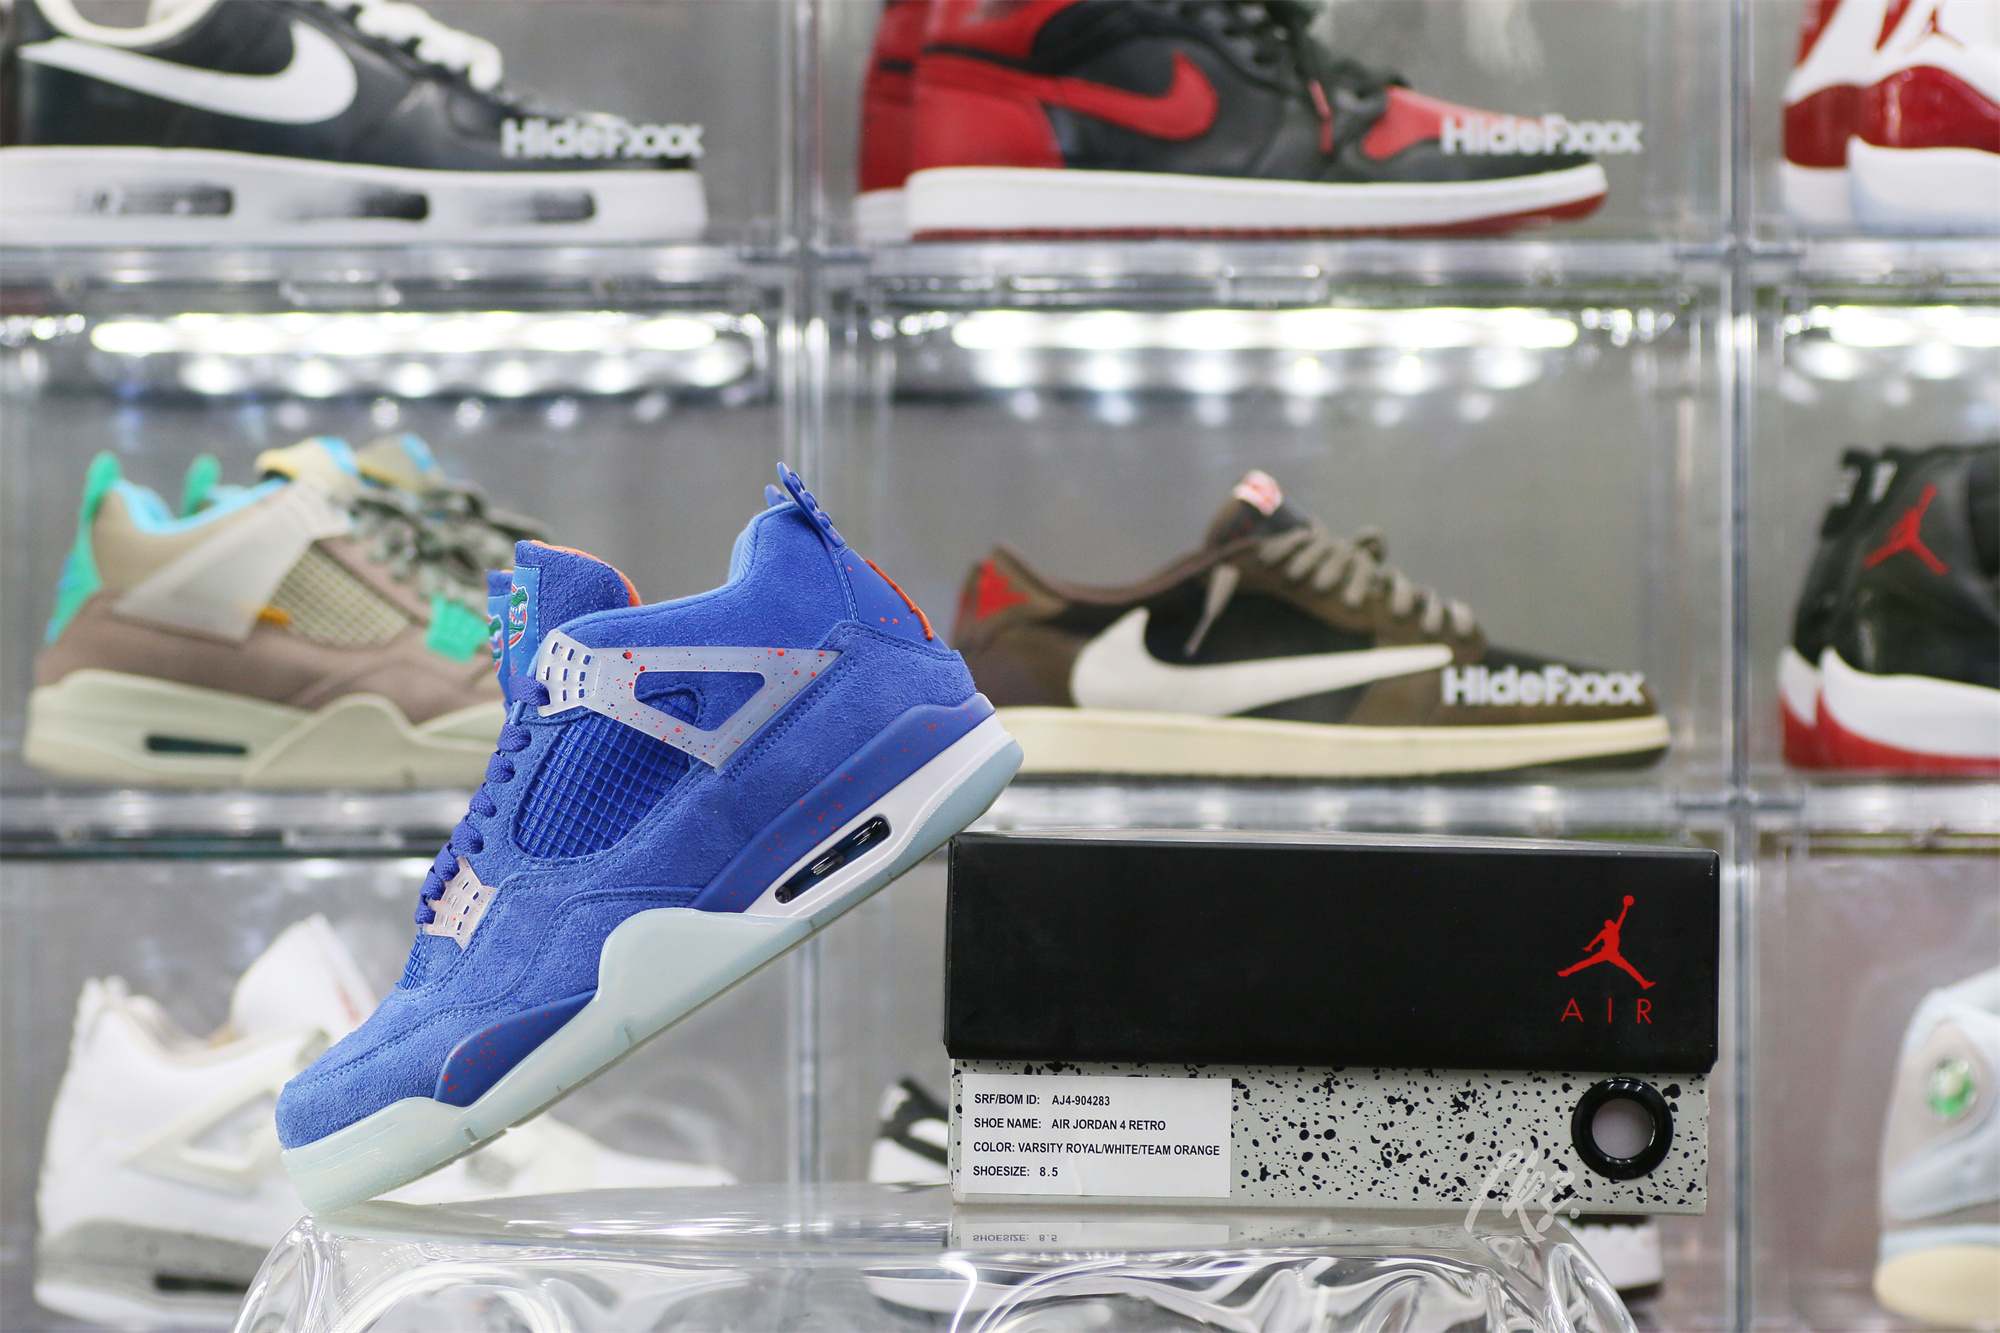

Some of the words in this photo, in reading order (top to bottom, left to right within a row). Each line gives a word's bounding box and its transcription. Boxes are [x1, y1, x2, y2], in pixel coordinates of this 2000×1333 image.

[1441, 664, 1645, 706] HideFxxx
[1560, 997, 1652, 1024] AIR
[974, 1093, 1024, 1106] SRF/BOM
[1026, 1094, 1041, 1106] ID:
[1051, 1094, 1111, 1107] AJ4-904283
[973, 1117, 1005, 1129] SHOE
[1006, 1117, 1042, 1130] NAME:
[1051, 1119, 1071, 1130] AIR
[1072, 1119, 1118, 1131] JORDAN
[1119, 1119, 1127, 1131] 4
[1128, 1119, 1167, 1131] RETRO
[973, 1141, 1016, 1153] COLOR:
[1017, 1142, 1064, 1154] VARSITY
[1065, 1142, 1171, 1156] ROYAL/WHITE/TEAM
[1173, 1144, 1221, 1156] ORANGE
[972, 1165, 1030, 1177] SHOESIZE:
[1039, 1166, 1059, 1178] 8.5
